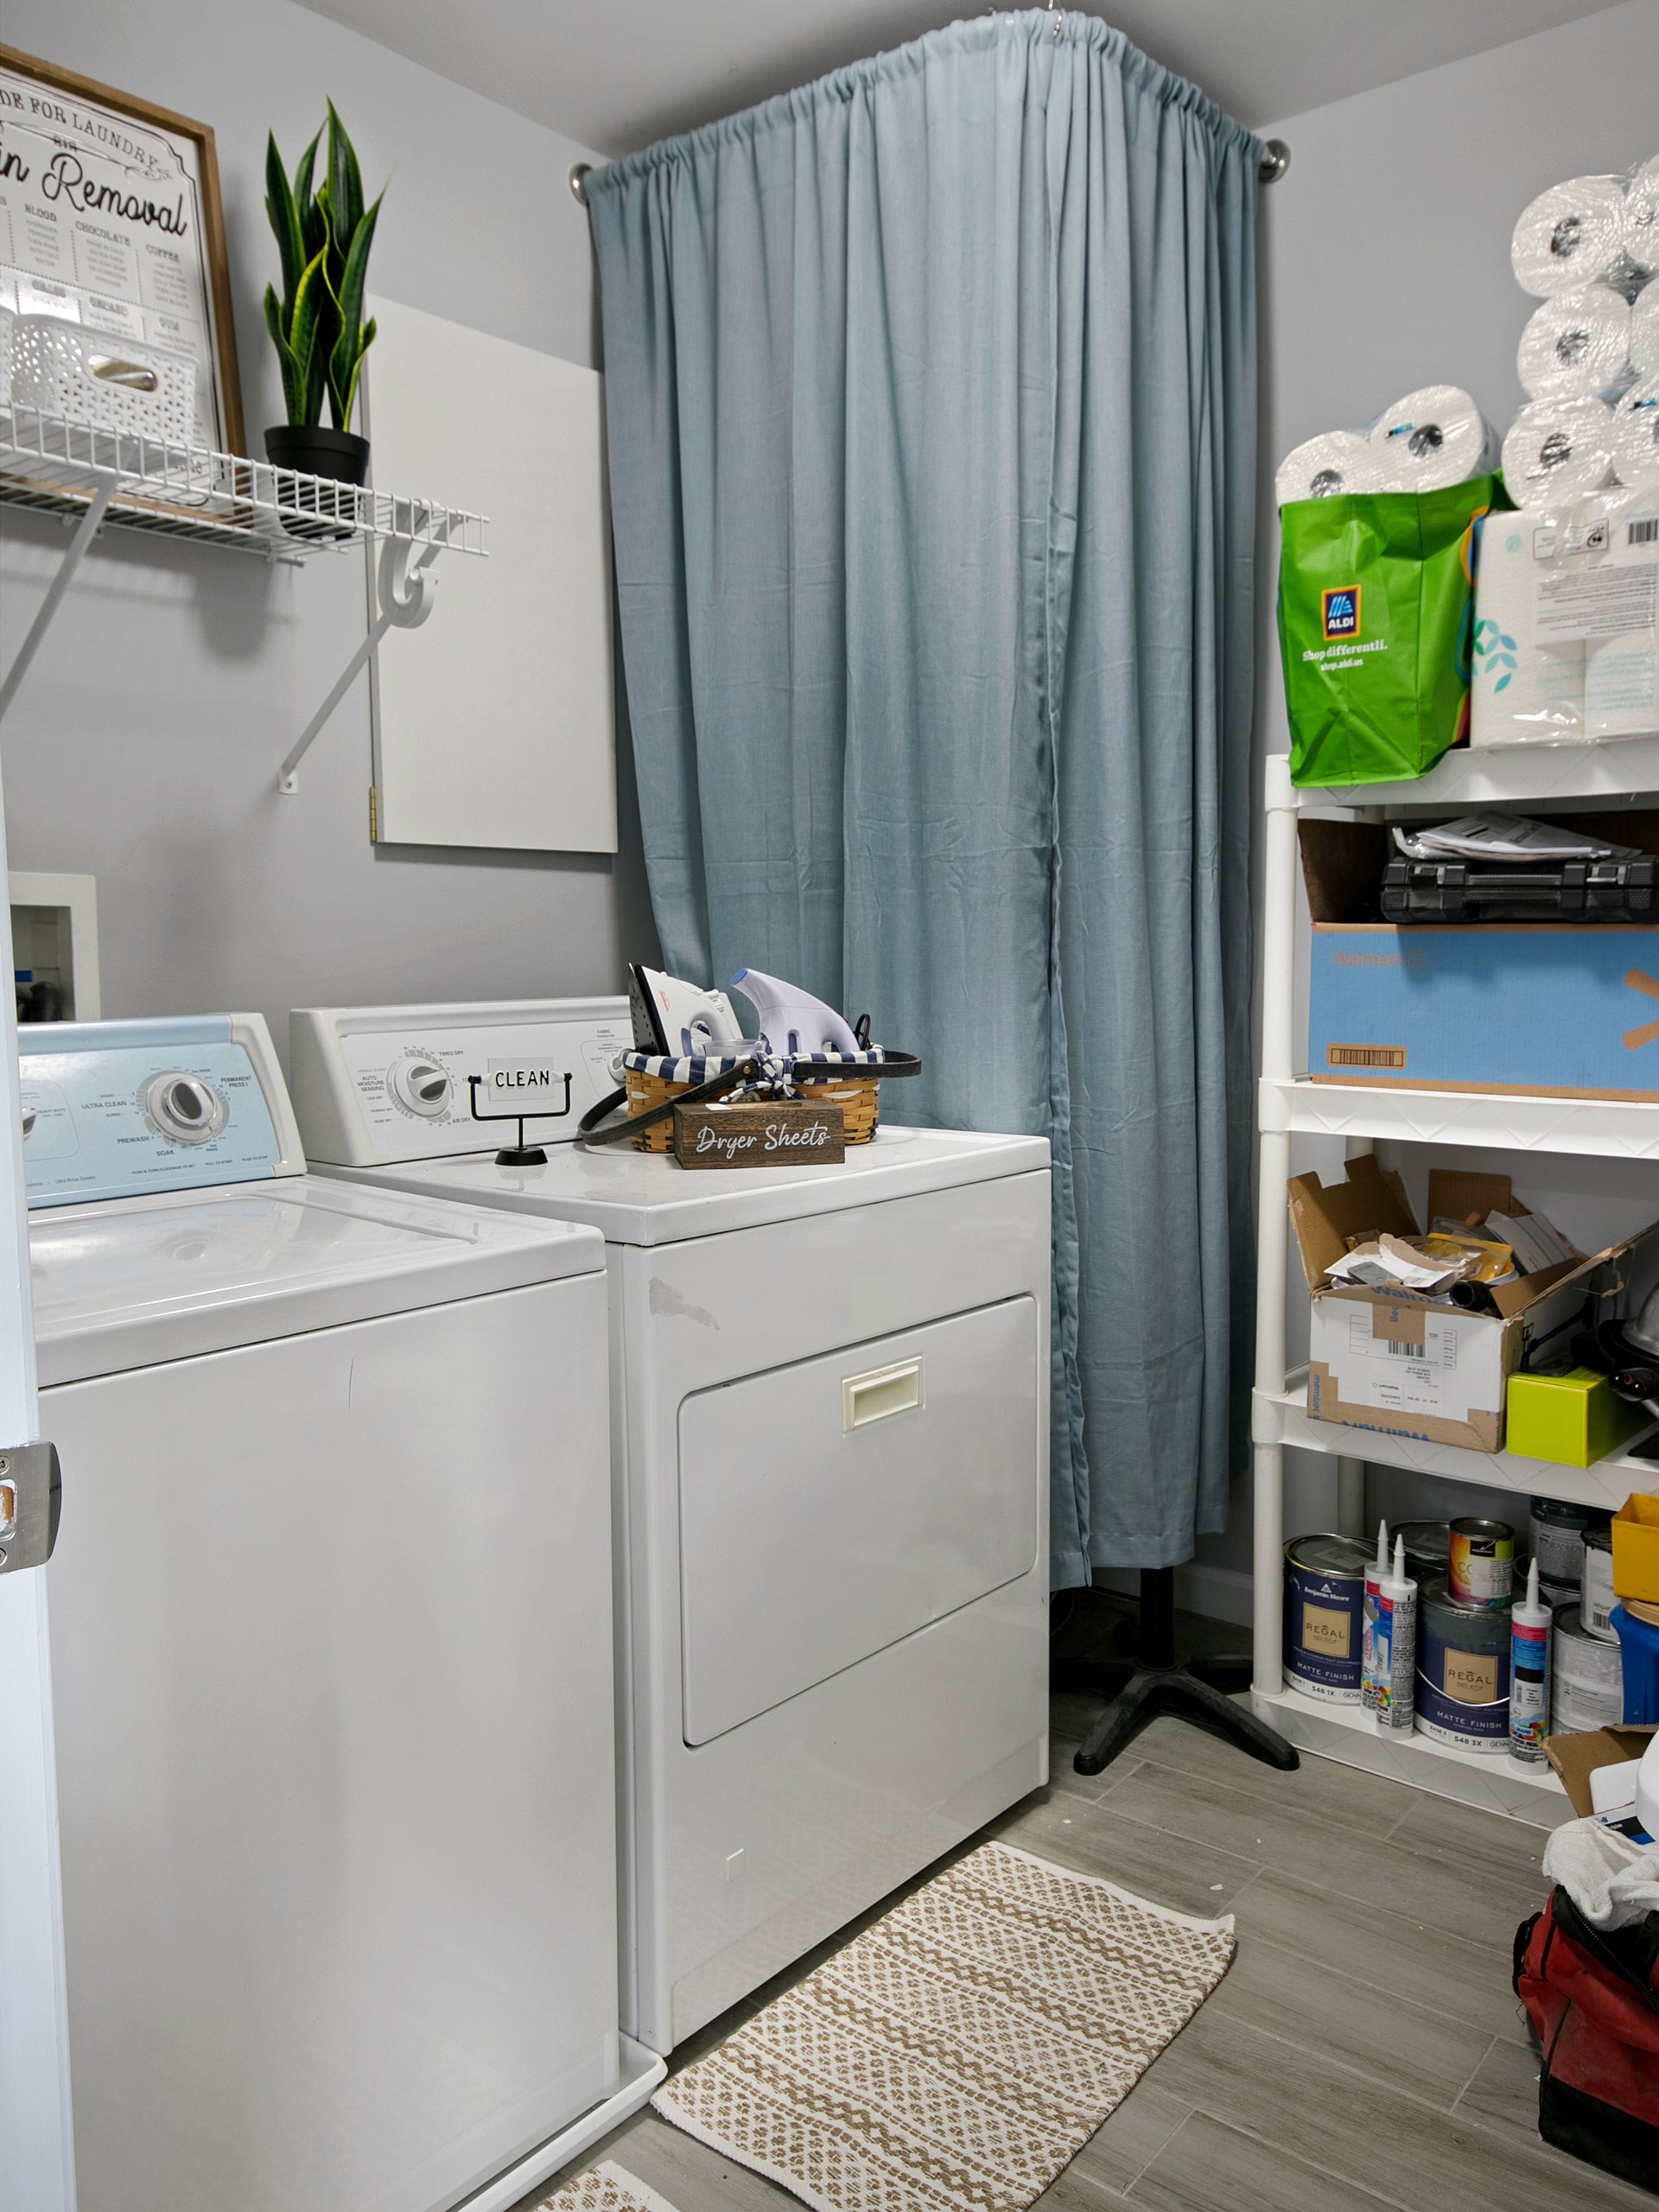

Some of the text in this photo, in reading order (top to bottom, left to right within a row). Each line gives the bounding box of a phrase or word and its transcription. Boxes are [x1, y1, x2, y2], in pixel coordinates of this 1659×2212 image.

[30, 98, 67, 124] FOR
[73, 112, 160, 169] LAUNDRY
[42, 152, 188, 236] Removal
[24, 203, 57, 222] BLOOD
[75, 220, 130, 245] CHOCOLATE
[145, 244, 181, 262] COFFEE
[1328, 616, 1354, 630] ALDI
[1302, 649, 1326, 662] Shop
[1333, 951, 1402, 968] Walmart
[495, 1070, 550, 1088] CLEAN
[117, 1135, 149, 1144] PREWASH
[696, 1121, 831, 1160] Dryer Sheets
[1304, 1586, 1350, 1602] Benjamin Moore
[1306, 1623, 1345, 1639] REGAL
[1313, 1635, 1337, 1644] SELECT
[1297, 1662, 1354, 1681] MATTE FINISH
[1448, 1669, 1493, 1685] REGAL
[1312, 1685, 1325, 1694] 548
[1457, 1681, 1484, 1692] SELECT
[1437, 1711, 1502, 1729] MATTE FINISH
[1454, 1736, 1469, 1745] 548
